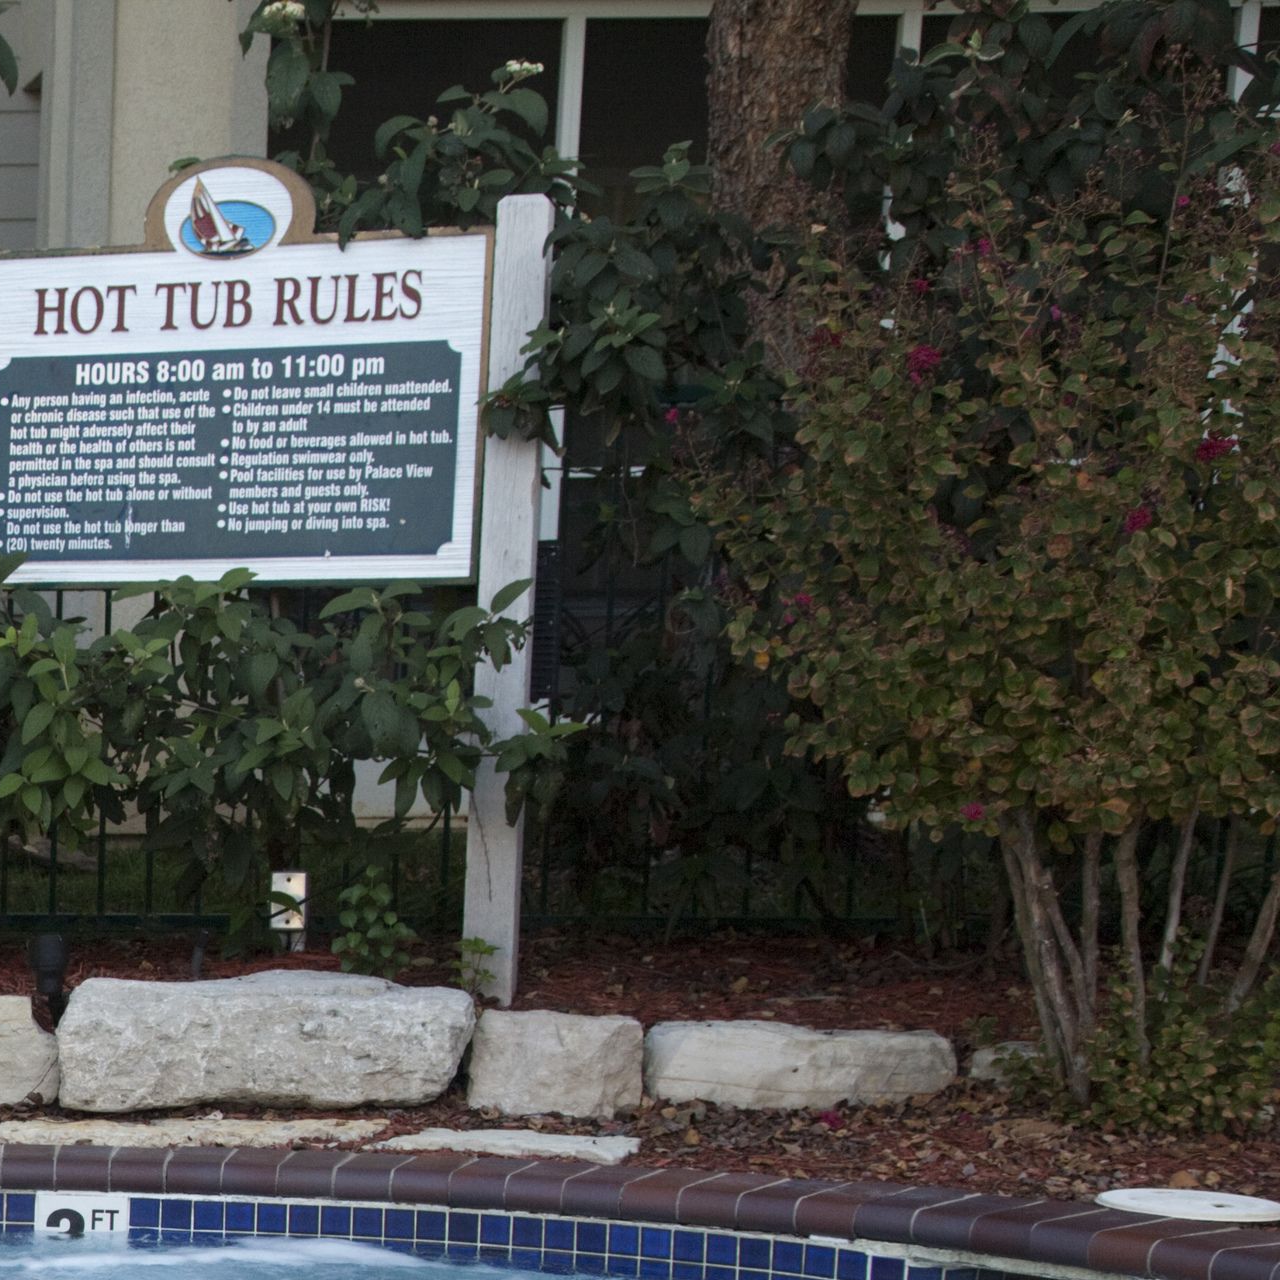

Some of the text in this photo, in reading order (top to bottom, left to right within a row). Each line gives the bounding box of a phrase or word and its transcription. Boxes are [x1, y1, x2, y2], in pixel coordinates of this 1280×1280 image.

[34, 269, 423, 335] HOT TUB RULES
[76, 354, 385, 386] HOURS 8:00 am to 11:00 pm
[12, 388, 210, 410] Any person having an infection, acute
[234, 380, 452, 400] Do not leave small children unattended.
[11, 404, 215, 423] or chronic disease such that use of the
[233, 397, 430, 417] Children under 14 must be attended
[10, 420, 196, 441] hot tub might adversely affect their
[232, 417, 308, 436] to by an adult
[10, 437, 195, 455] health or the health of others is not
[232, 429, 452, 450] No food or beverages allowed in hot tub.
[9, 452, 215, 474] permitted in the spa and should consult
[231, 448, 375, 469] Regulation swimwear only.
[9, 470, 181, 490] a physician before using the spa.
[230, 463, 433, 482] Pool facilities for use by Palace View
[8, 485, 212, 503] Do not use the hot tub alone or without
[229, 481, 369, 500] members and guests only.
[7, 504, 69, 522] supervision.
[229, 497, 390, 516] Use hot tub at your own RISK!
[7, 518, 185, 535] Do not use the hot tub longer than
[228, 515, 389, 534] No jumping or diving into spa.
[7, 536, 112, 553] (20) twenty minutes.
[91, 1209, 120, 1231] FT
